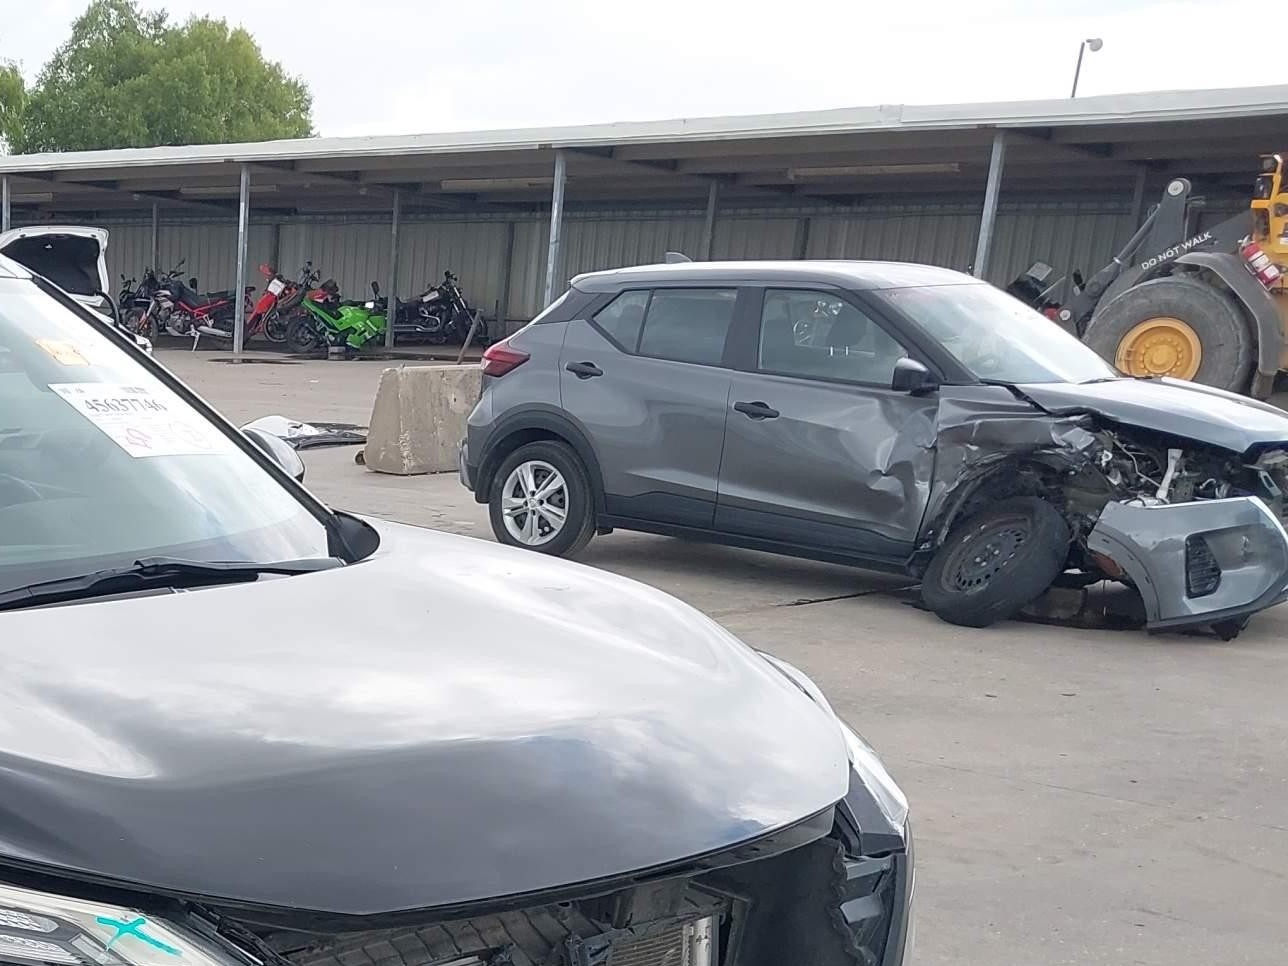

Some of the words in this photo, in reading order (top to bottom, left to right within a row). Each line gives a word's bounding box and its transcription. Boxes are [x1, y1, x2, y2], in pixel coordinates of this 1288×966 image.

[1141, 258, 1157, 270] DO
[1158, 246, 1180, 262] NOT
[1181, 231, 1212, 251] WALK
[83, 398, 168, 413] 45637746
